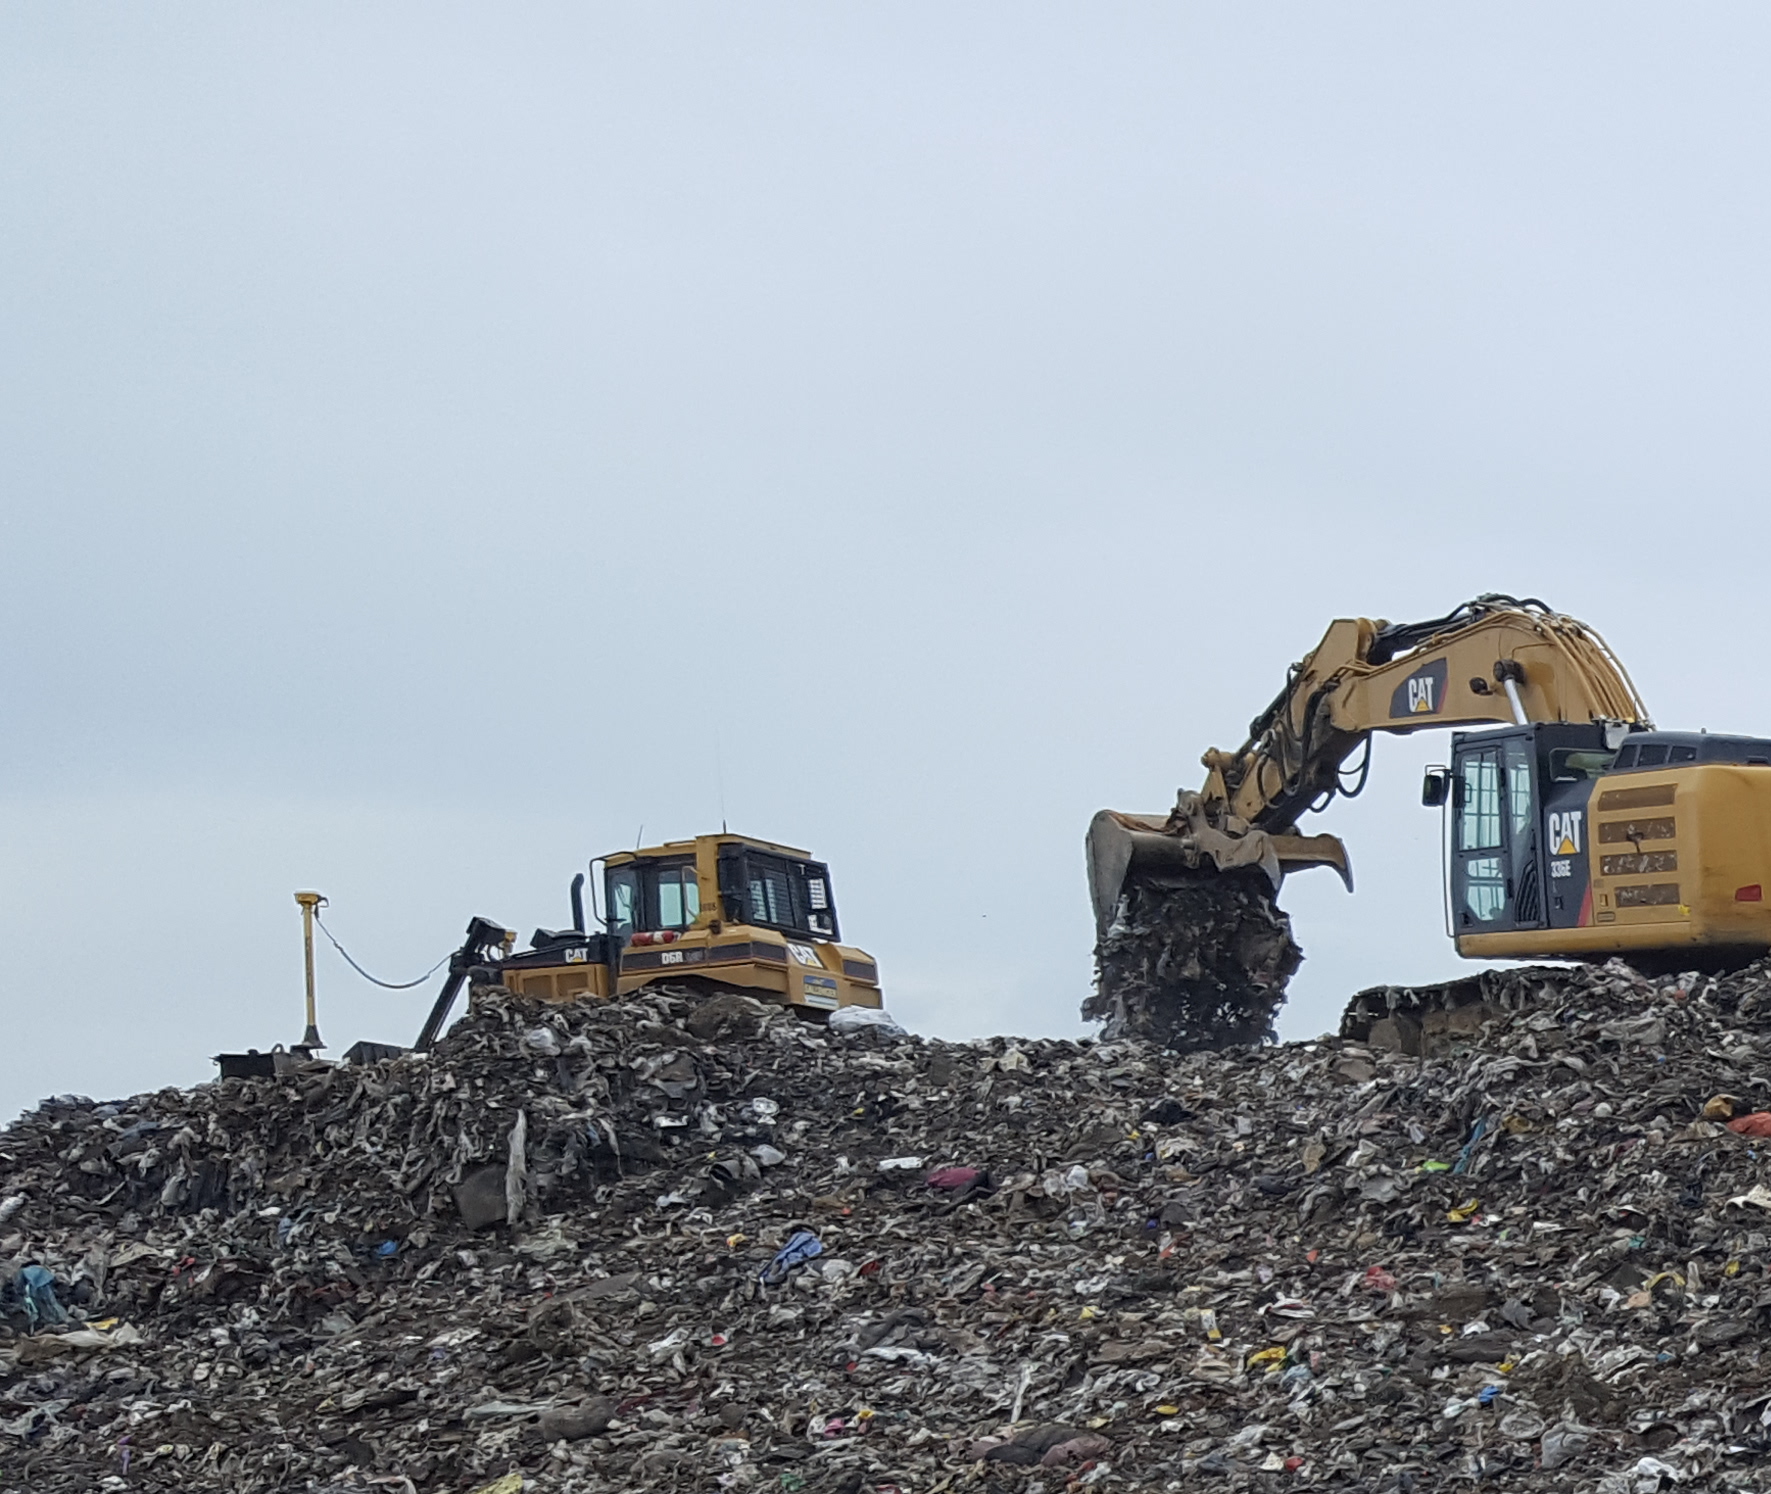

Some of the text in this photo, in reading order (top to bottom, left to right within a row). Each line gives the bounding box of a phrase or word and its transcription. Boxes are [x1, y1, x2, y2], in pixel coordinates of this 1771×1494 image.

[1409, 677, 1433, 712] CAT
[1549, 811, 1581, 855] CAT
[565, 948, 588, 963] CAT
[787, 943, 824, 969] CAT
